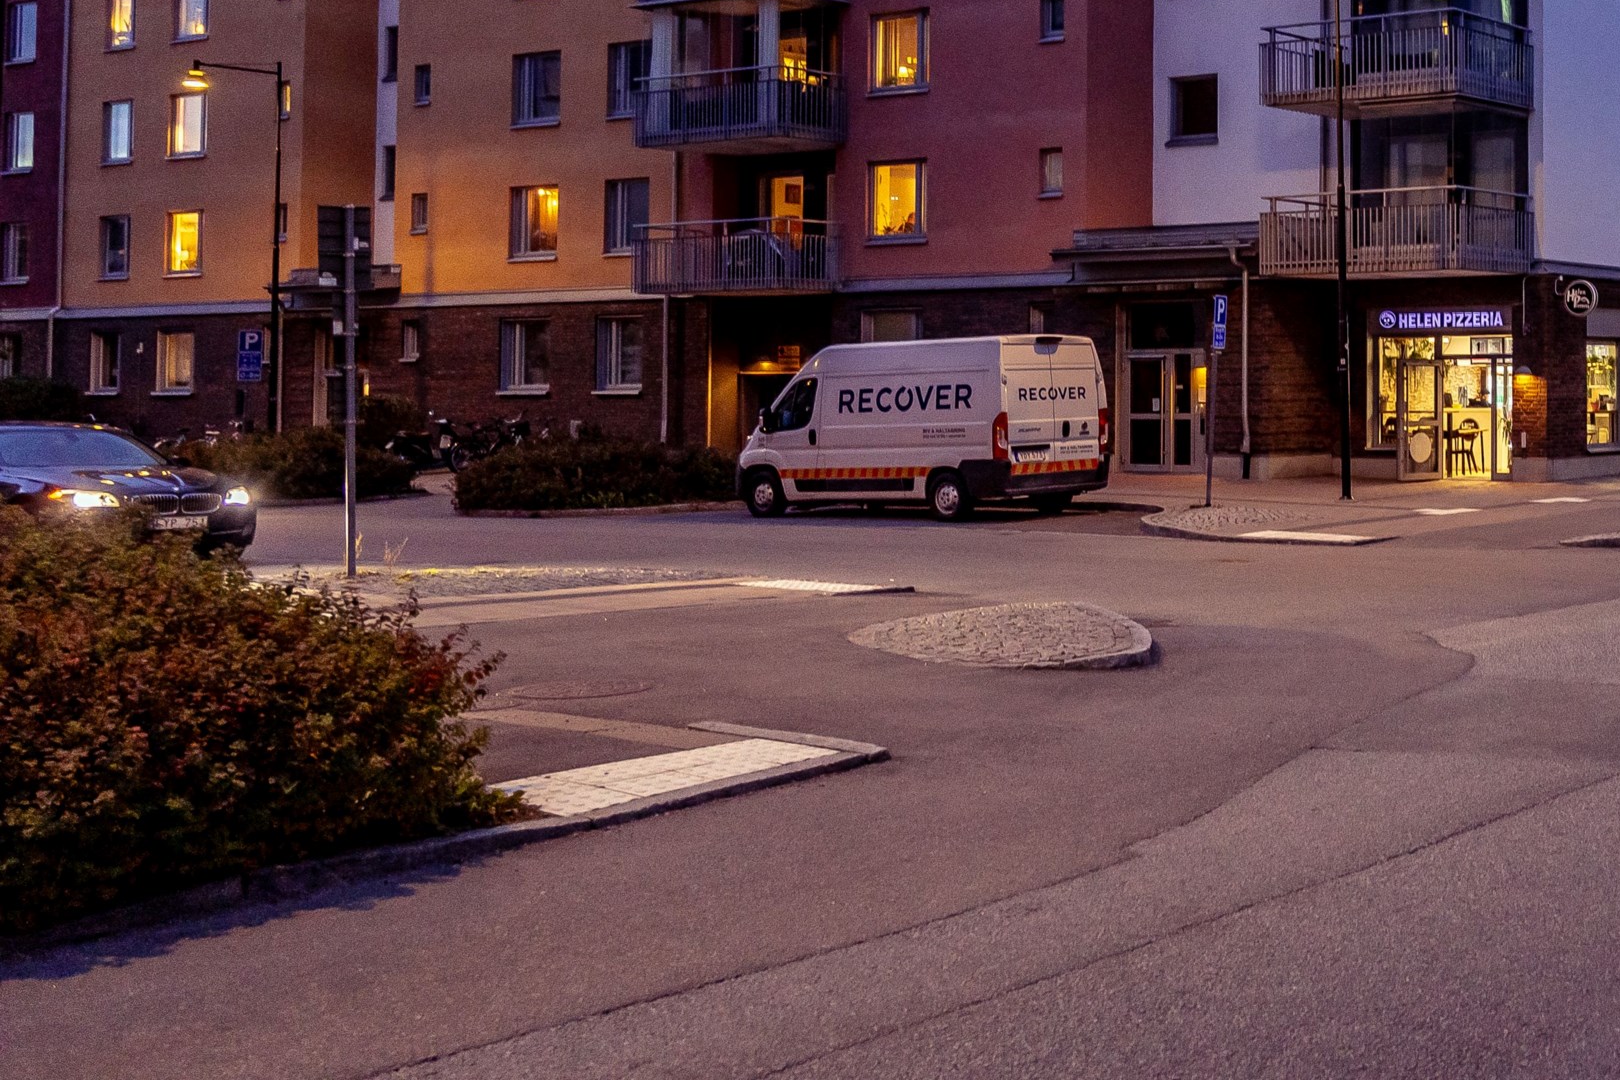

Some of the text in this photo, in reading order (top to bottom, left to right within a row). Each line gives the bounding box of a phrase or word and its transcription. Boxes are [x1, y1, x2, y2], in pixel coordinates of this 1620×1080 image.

[1217, 298, 1225, 322] P
[1399, 311, 1503, 329] HELEN PIZZERIA
[245, 332, 259, 350] P
[838, 384, 972, 413] RECOVER
[1018, 386, 1086, 401] RECOVER
